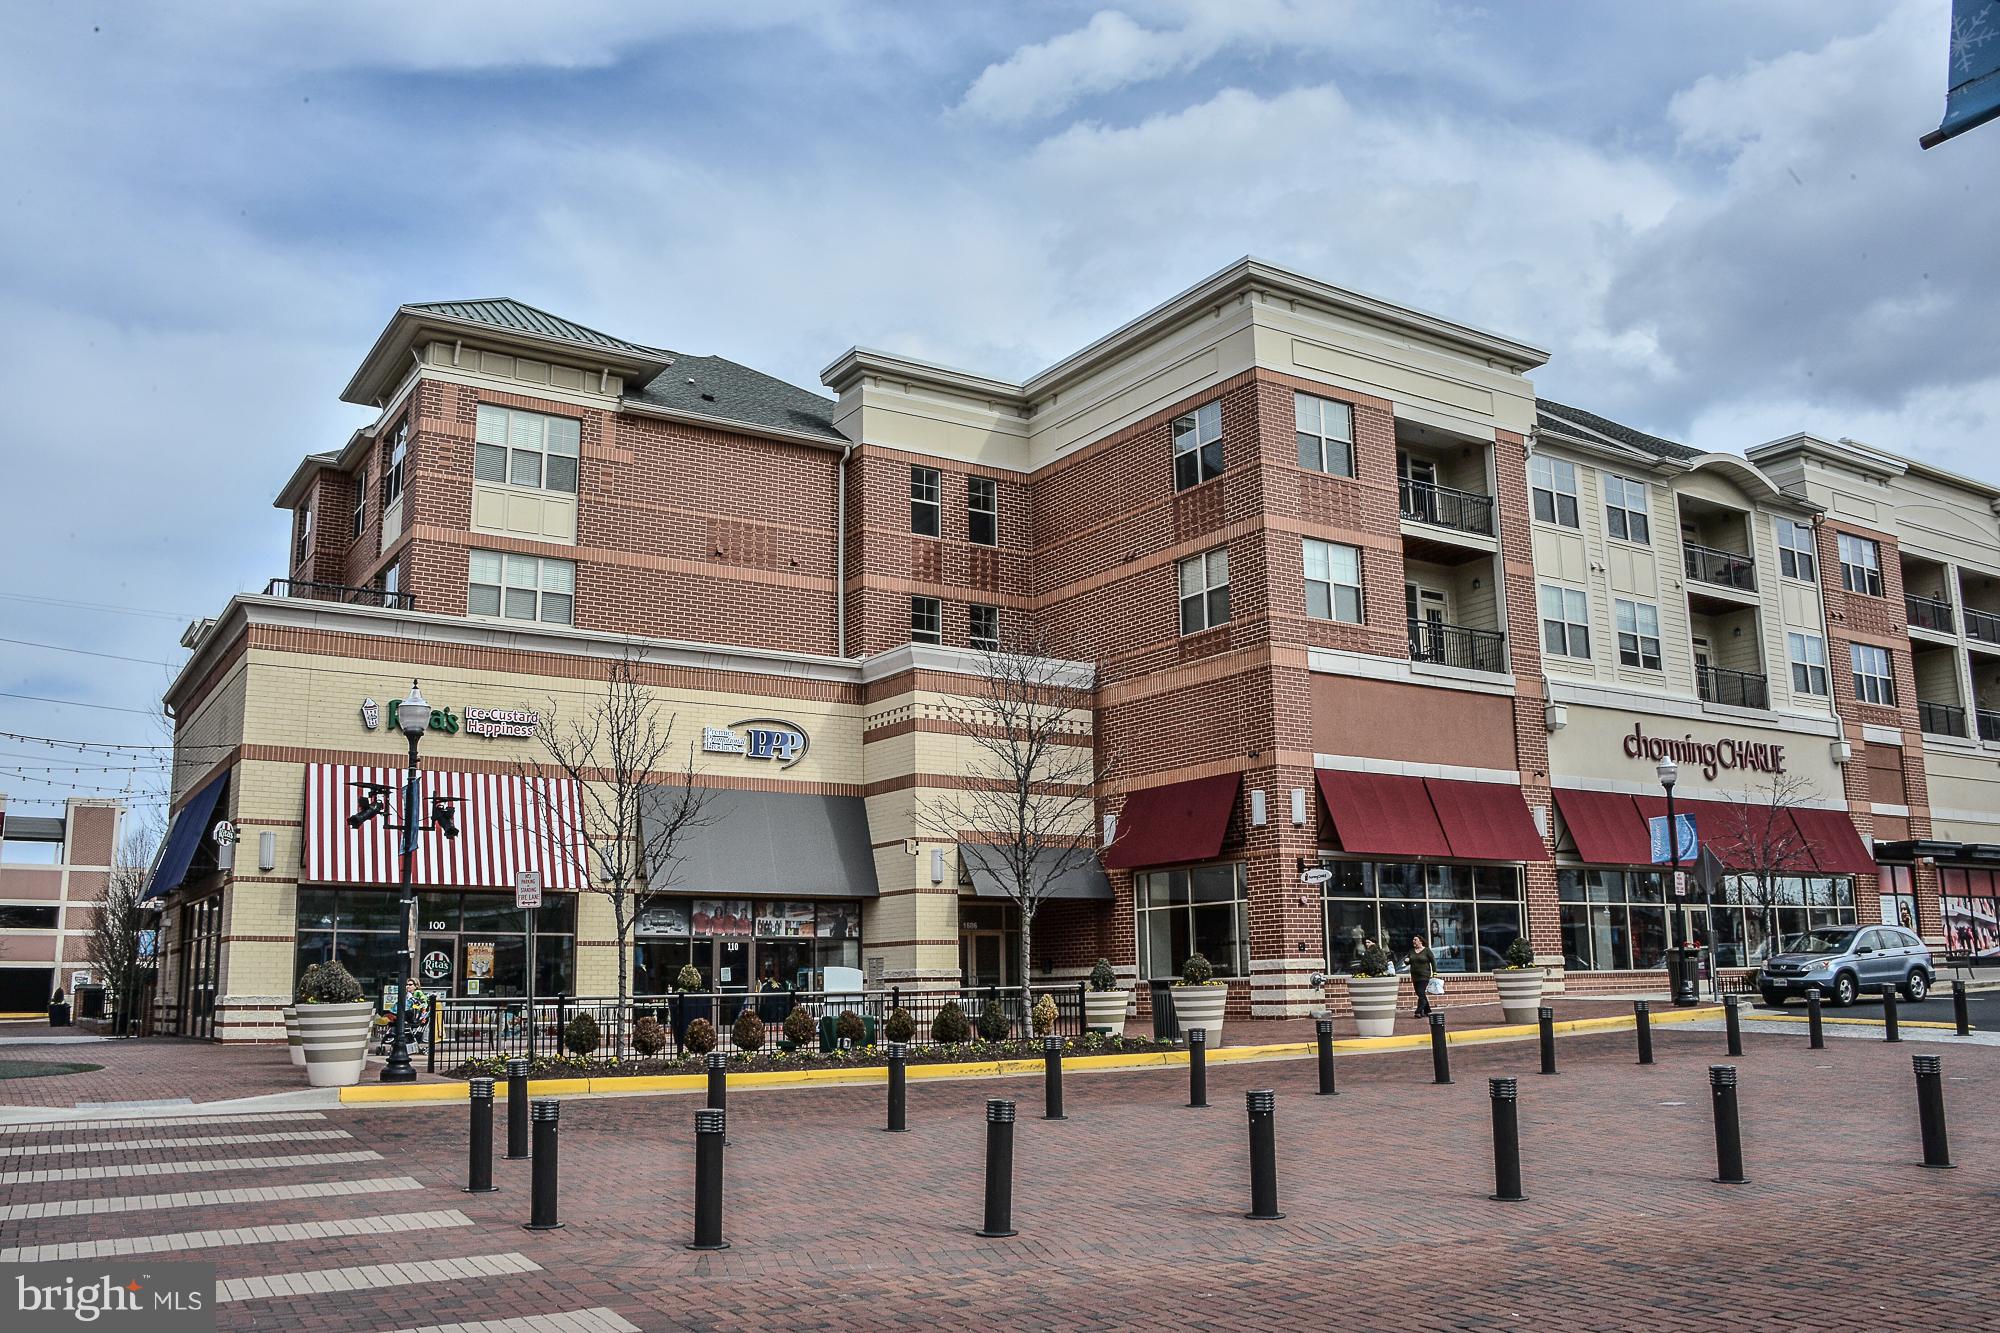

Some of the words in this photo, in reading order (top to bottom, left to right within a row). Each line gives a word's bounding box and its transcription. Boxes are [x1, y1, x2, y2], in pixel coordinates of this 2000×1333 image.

[706, 727, 735, 737] Premier
[706, 742, 738, 751] Products
[747, 729, 804, 760] PPP
[429, 921, 446, 930] 100
[727, 942, 739, 951] 110
[425, 959, 449, 970] Rita's
